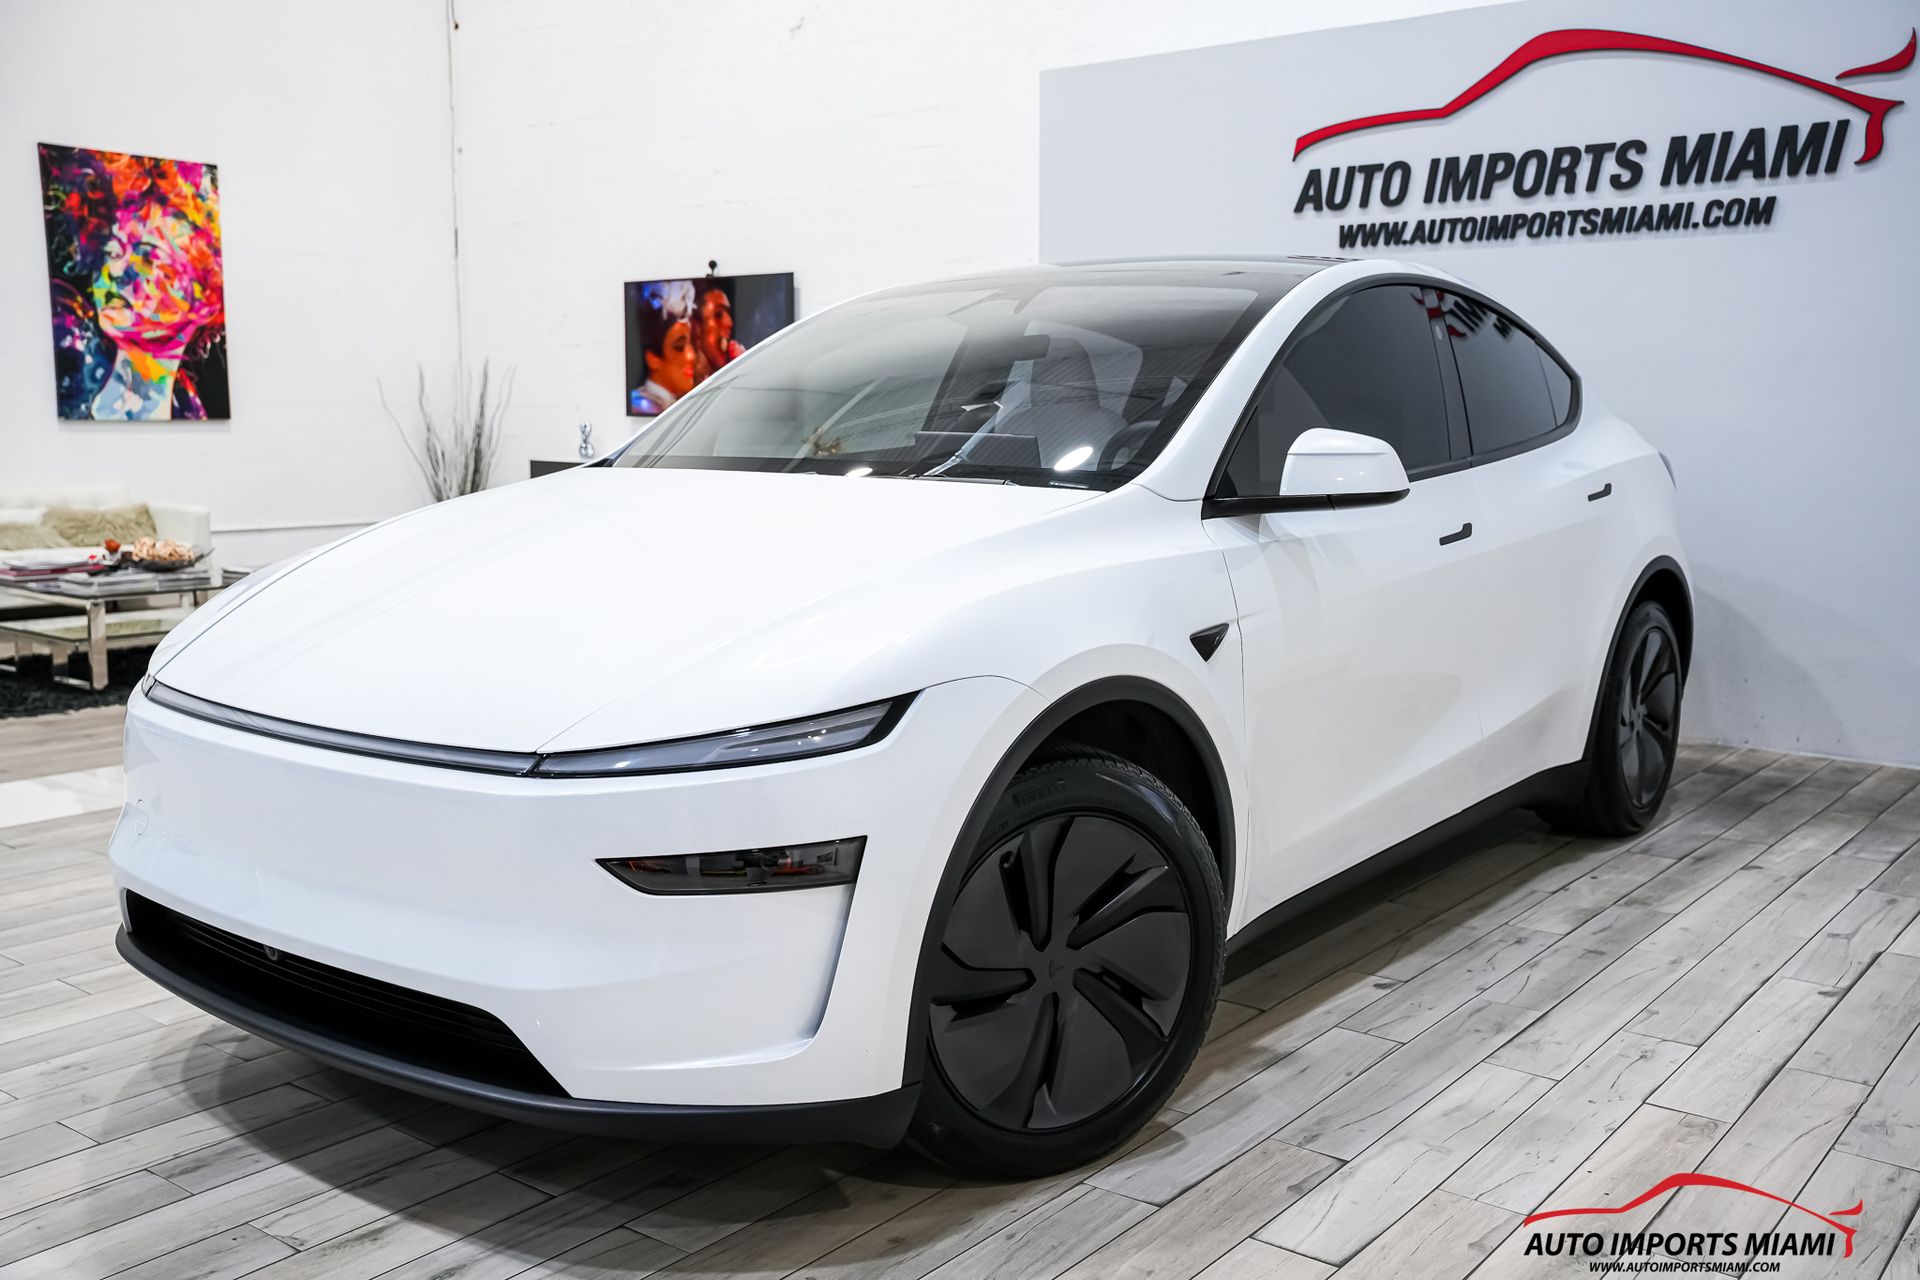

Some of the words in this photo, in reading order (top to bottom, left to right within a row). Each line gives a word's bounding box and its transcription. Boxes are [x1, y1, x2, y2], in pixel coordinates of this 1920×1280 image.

[1293, 160, 1412, 214] AUTO
[1423, 139, 1648, 204] IMPORTS
[1659, 119, 1851, 188] MIAMI
[1338, 196, 1777, 249] WWW.AUTOIMPORTSMIAMI.COM
